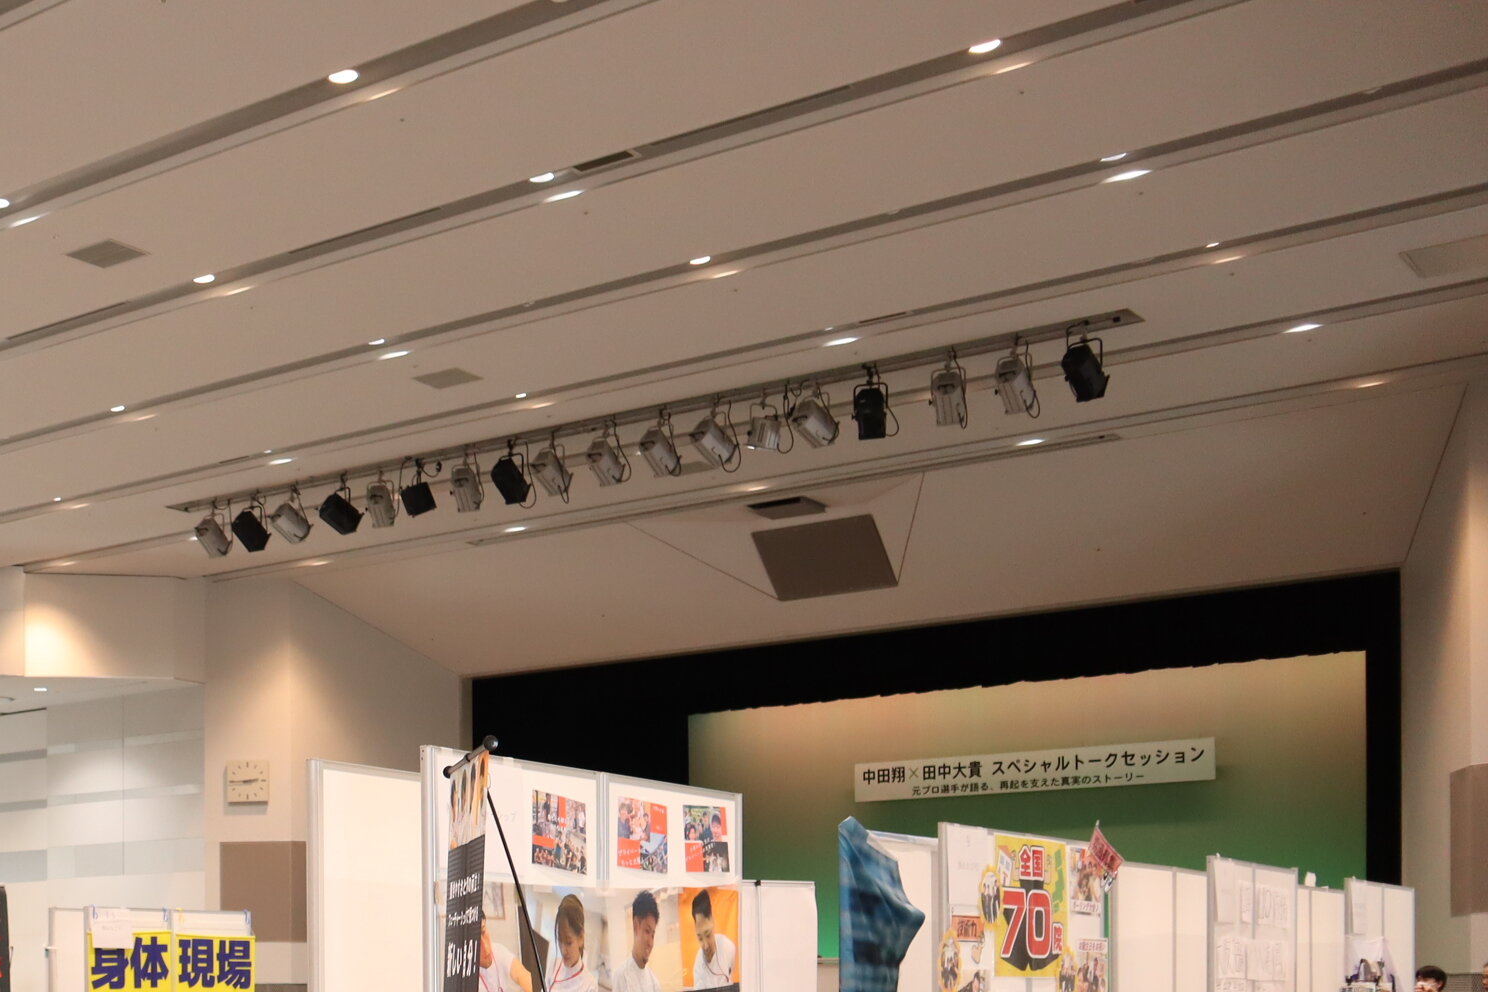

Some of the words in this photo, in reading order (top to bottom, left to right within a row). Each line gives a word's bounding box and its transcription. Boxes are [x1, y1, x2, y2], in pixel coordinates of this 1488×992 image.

[862, 761, 982, 785] 中田翔×田中大貴
[992, 747, 1205, 775] スペシャルトークセッション
[1019, 845, 1045, 880] 全国
[91, 936, 170, 990] 身体
[178, 938, 252, 989] 現場
